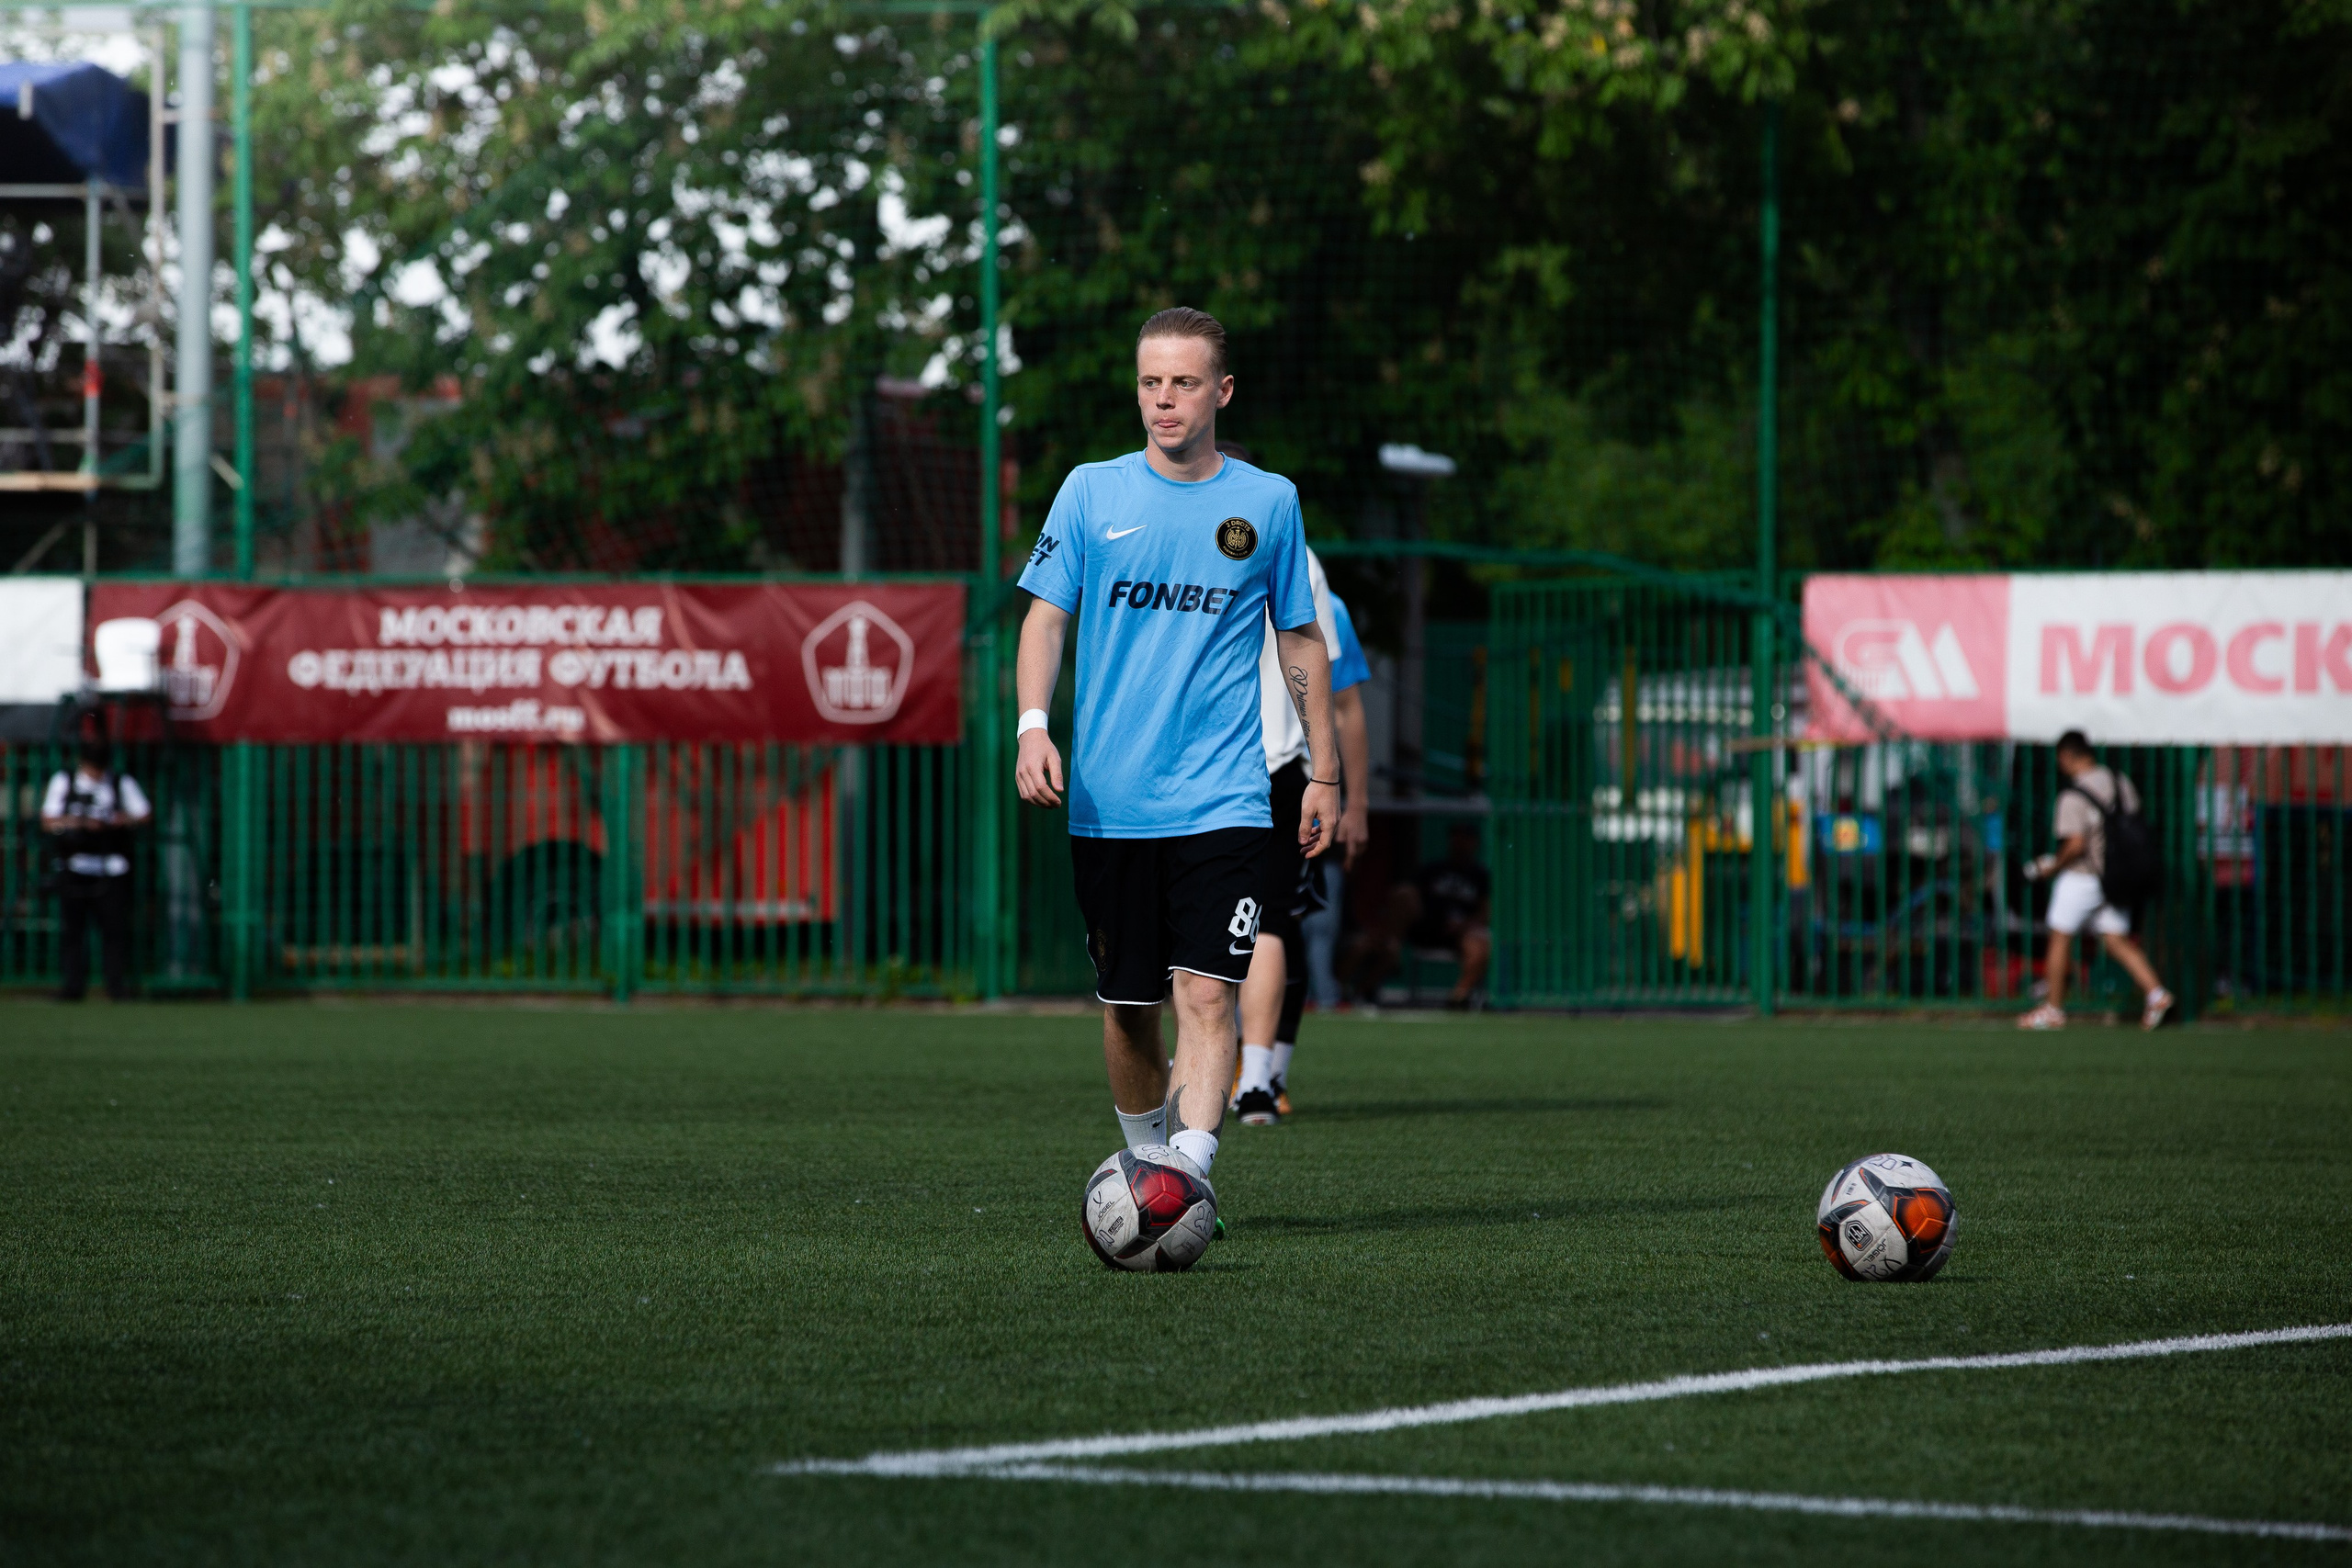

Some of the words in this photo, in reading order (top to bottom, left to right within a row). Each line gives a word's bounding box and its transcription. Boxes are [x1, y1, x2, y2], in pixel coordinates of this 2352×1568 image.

[1109, 581, 1240, 615] FONBET
[380, 606, 662, 645] МОСКОВСКАЯ
[288, 649, 542, 695] ФЕДЕРАЦИЯ
[550, 649, 752, 691] ФУТБОЛА
[2040, 621, 2352, 695] МОСК
